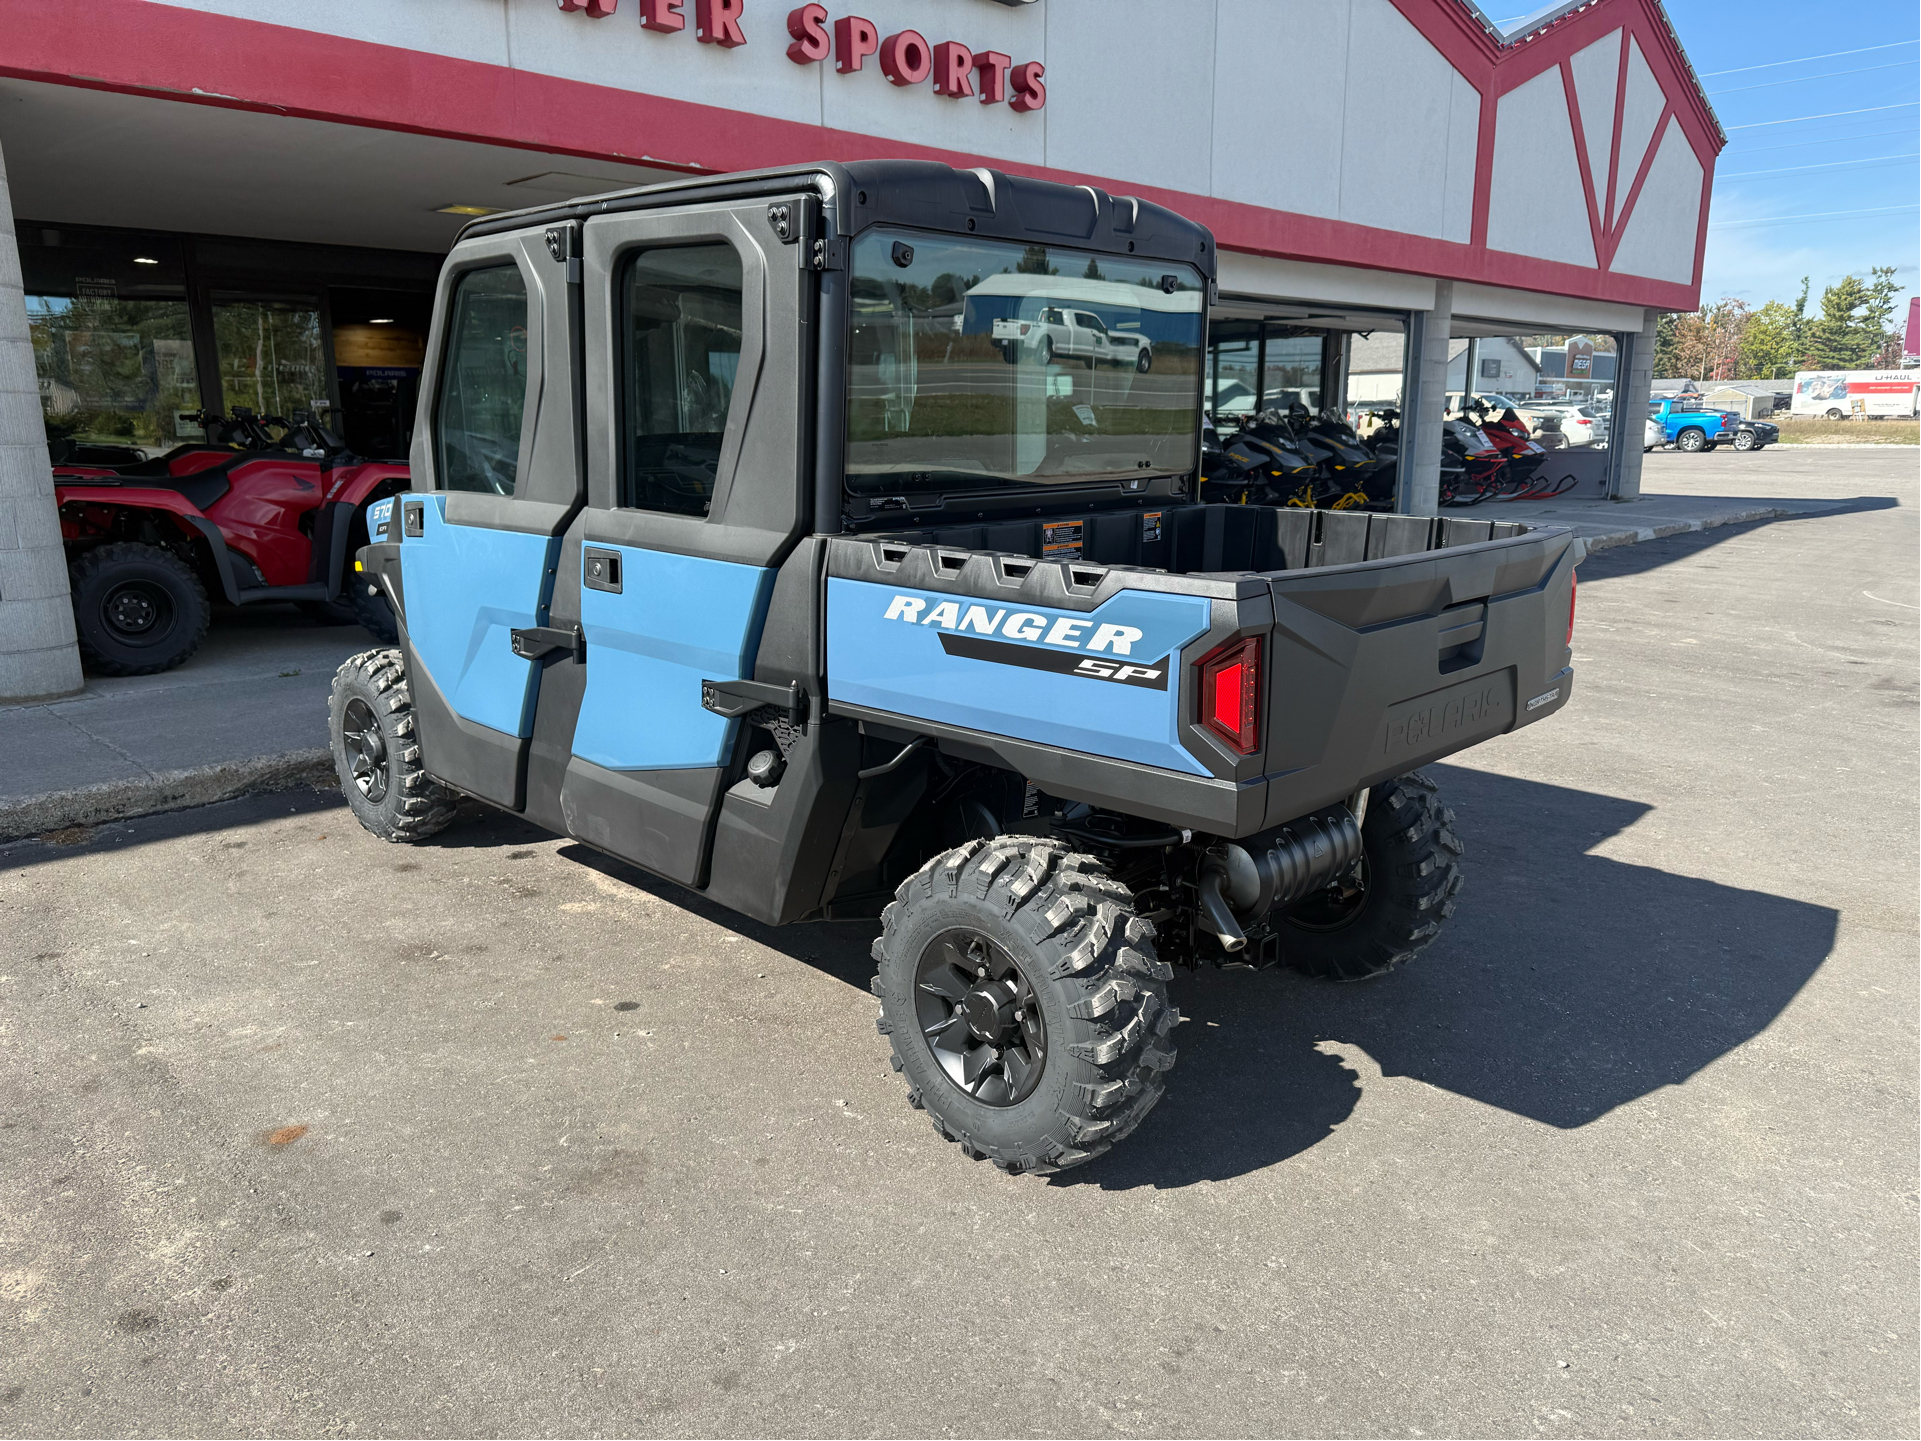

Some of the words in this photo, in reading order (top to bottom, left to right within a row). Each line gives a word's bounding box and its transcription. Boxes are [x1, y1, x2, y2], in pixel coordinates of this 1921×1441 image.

[557, 0, 747, 48] ER
[786, 3, 1046, 113] SPORTS
[82, 288, 112, 296] FACTORY
[366, 369, 407, 377] POLARIS
[1572, 359, 1591, 370] MEGA
[373, 503, 393, 520] 570
[883, 595, 1143, 656] RANGER
[1073, 659, 1163, 681] SP
[1385, 685, 1500, 755] POLARIS
